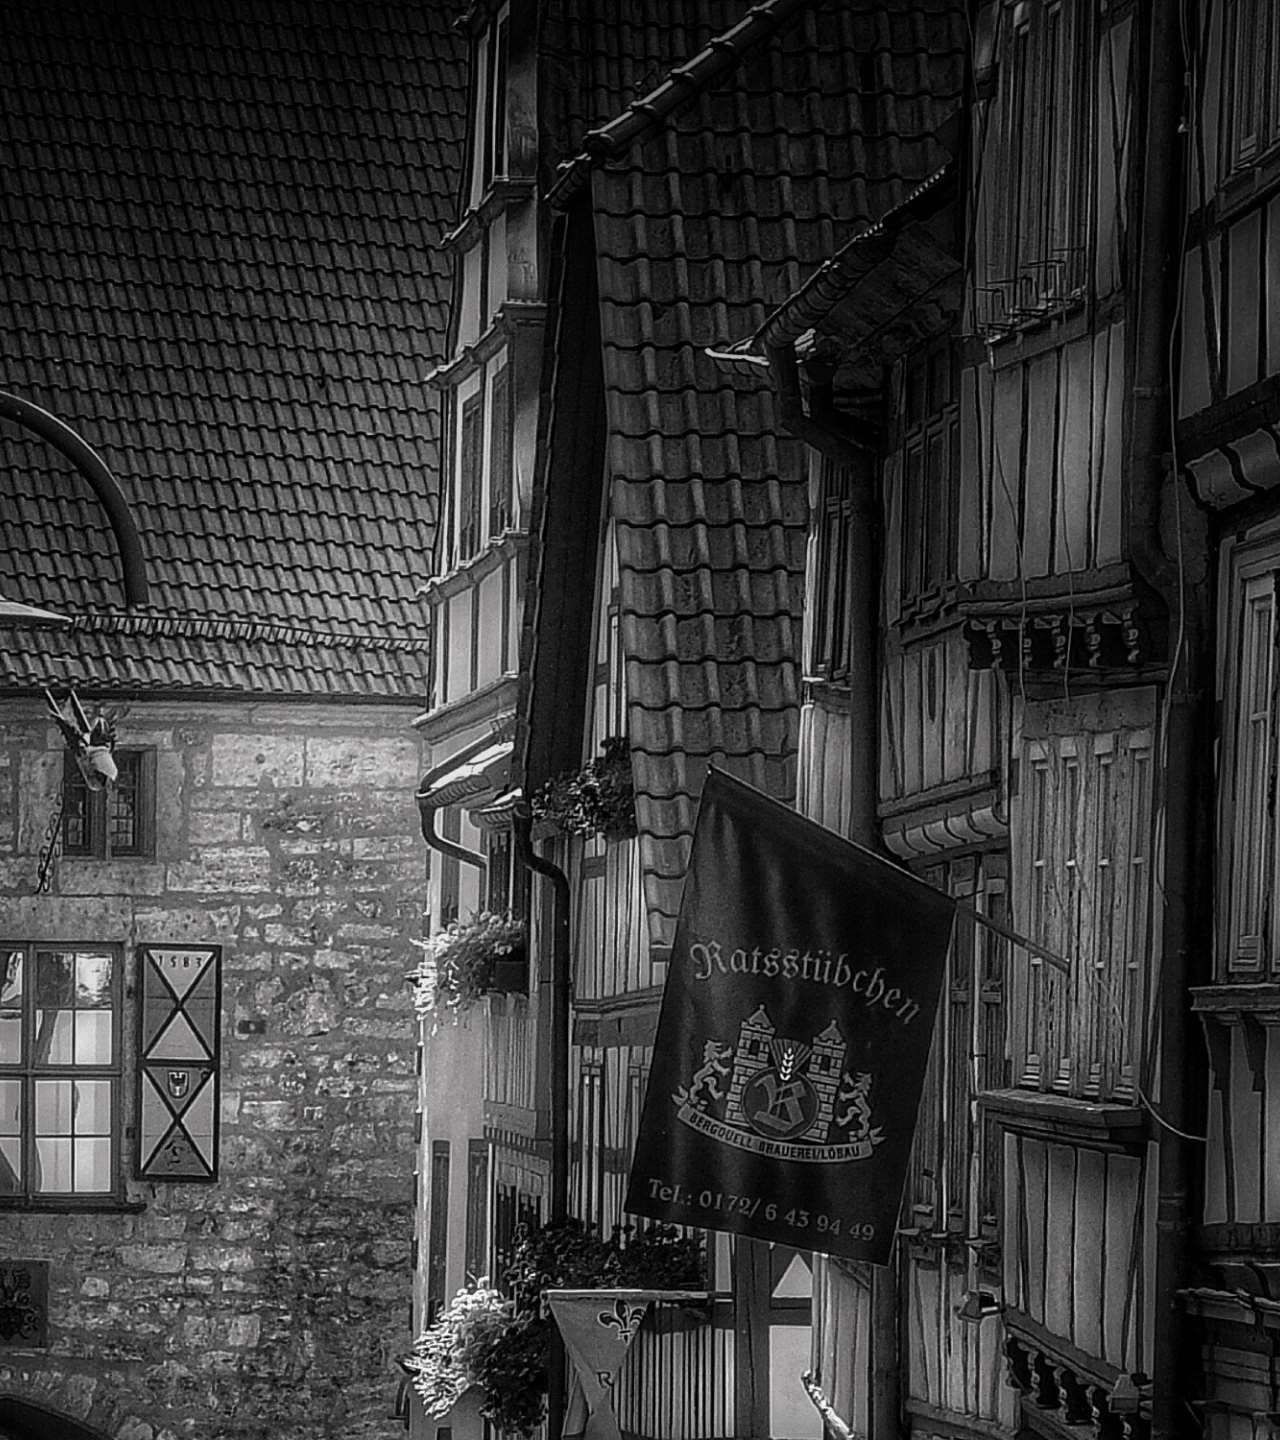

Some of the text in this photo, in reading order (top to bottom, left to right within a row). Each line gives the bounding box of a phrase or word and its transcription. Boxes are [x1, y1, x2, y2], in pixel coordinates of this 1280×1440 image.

[689, 939, 920, 1025] Ratsstübchen
[648, 1178, 693, 1206] Tel.:
[764, 1203, 778, 1222] 6
[783, 1207, 812, 1229] 43
[816, 1214, 842, 1236] 94
[848, 1222, 876, 1242] 49
